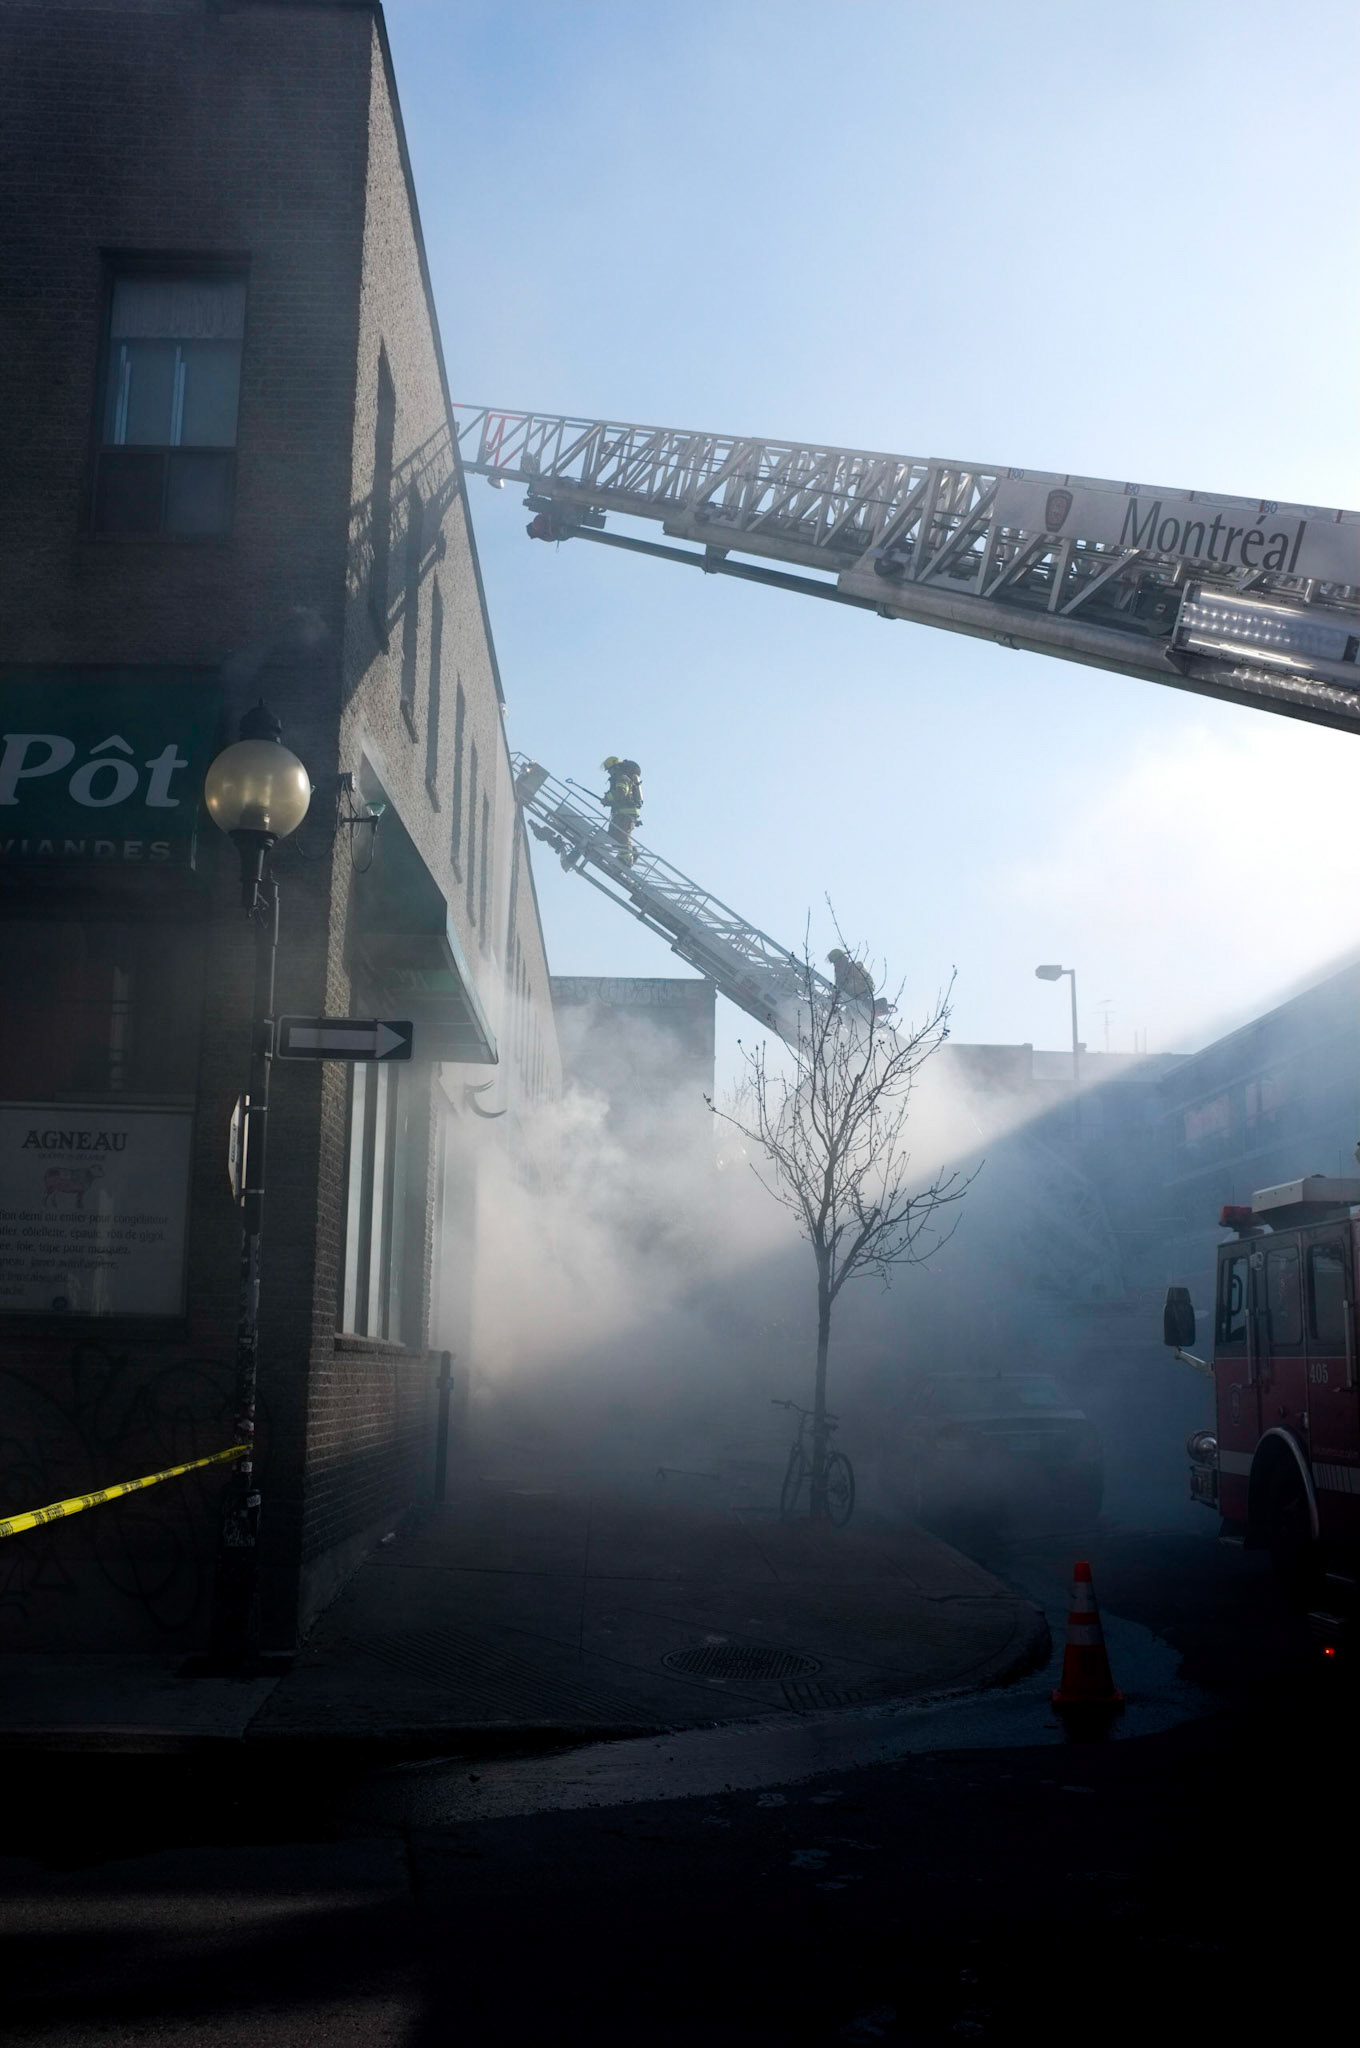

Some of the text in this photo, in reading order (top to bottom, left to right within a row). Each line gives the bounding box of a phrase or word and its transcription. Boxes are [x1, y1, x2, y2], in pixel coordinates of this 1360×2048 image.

[1128, 483, 1140, 496] 90
[1264, 501, 1278, 514] 80
[1119, 497, 1307, 573] Montréal
[0, 734, 189, 807] Pôt
[0, 839, 171, 861] VIANDES
[22, 1130, 128, 1151] AGNEAU
[1309, 1363, 1329, 1384] 405
